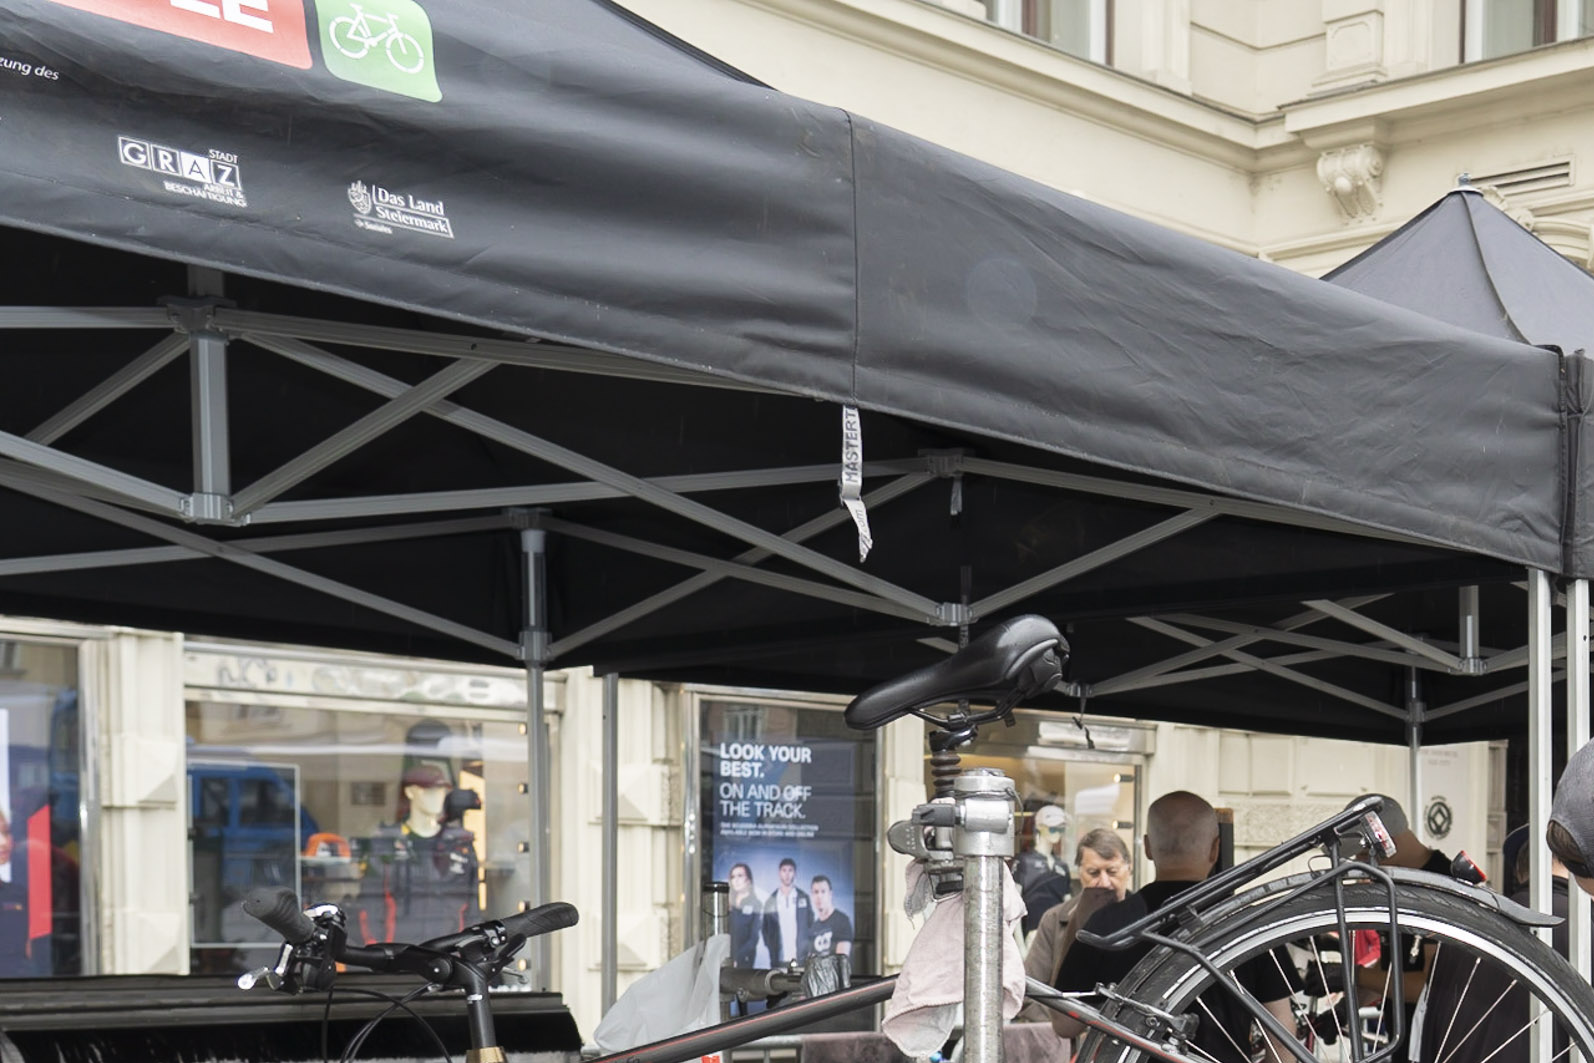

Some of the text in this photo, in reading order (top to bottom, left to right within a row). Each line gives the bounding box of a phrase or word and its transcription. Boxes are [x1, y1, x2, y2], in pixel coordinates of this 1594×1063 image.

[35, 67, 60, 81] des
[120, 141, 238, 188] GRAZ
[209, 149, 239, 164] STADT
[378, 187, 446, 216] Das Land
[375, 205, 449, 233] Steiermark
[720, 742, 813, 764] LOOK YOUR
[720, 760, 765, 779] BEST.
[719, 782, 813, 802] ON AND OFF
[719, 801, 807, 819] THE TRACK.
